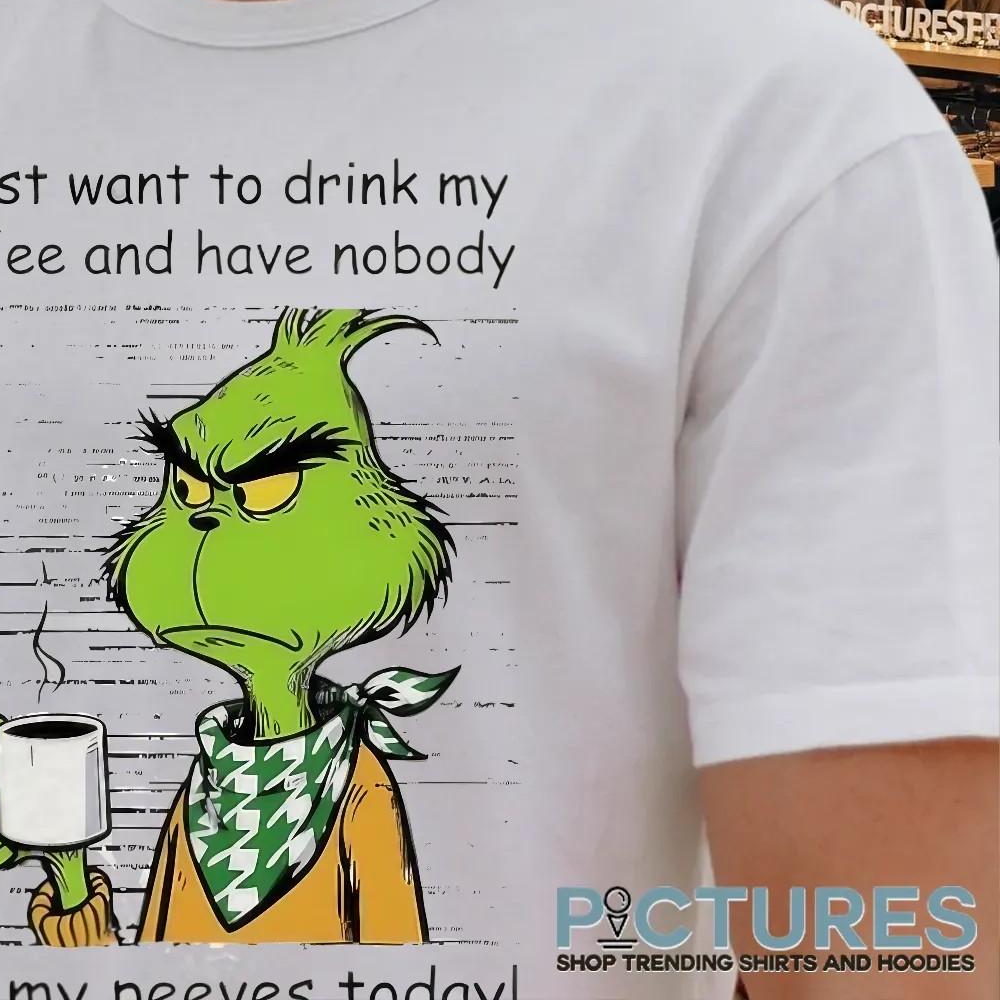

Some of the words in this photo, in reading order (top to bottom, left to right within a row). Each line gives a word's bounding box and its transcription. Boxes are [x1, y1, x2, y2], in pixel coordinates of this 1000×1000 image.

[68, 164, 190, 206] want
[209, 164, 262, 205] to
[284, 158, 418, 206] drink
[439, 173, 509, 220] my
[84, 228, 173, 276] and
[197, 228, 313, 275] have
[334, 229, 517, 290] nobody
